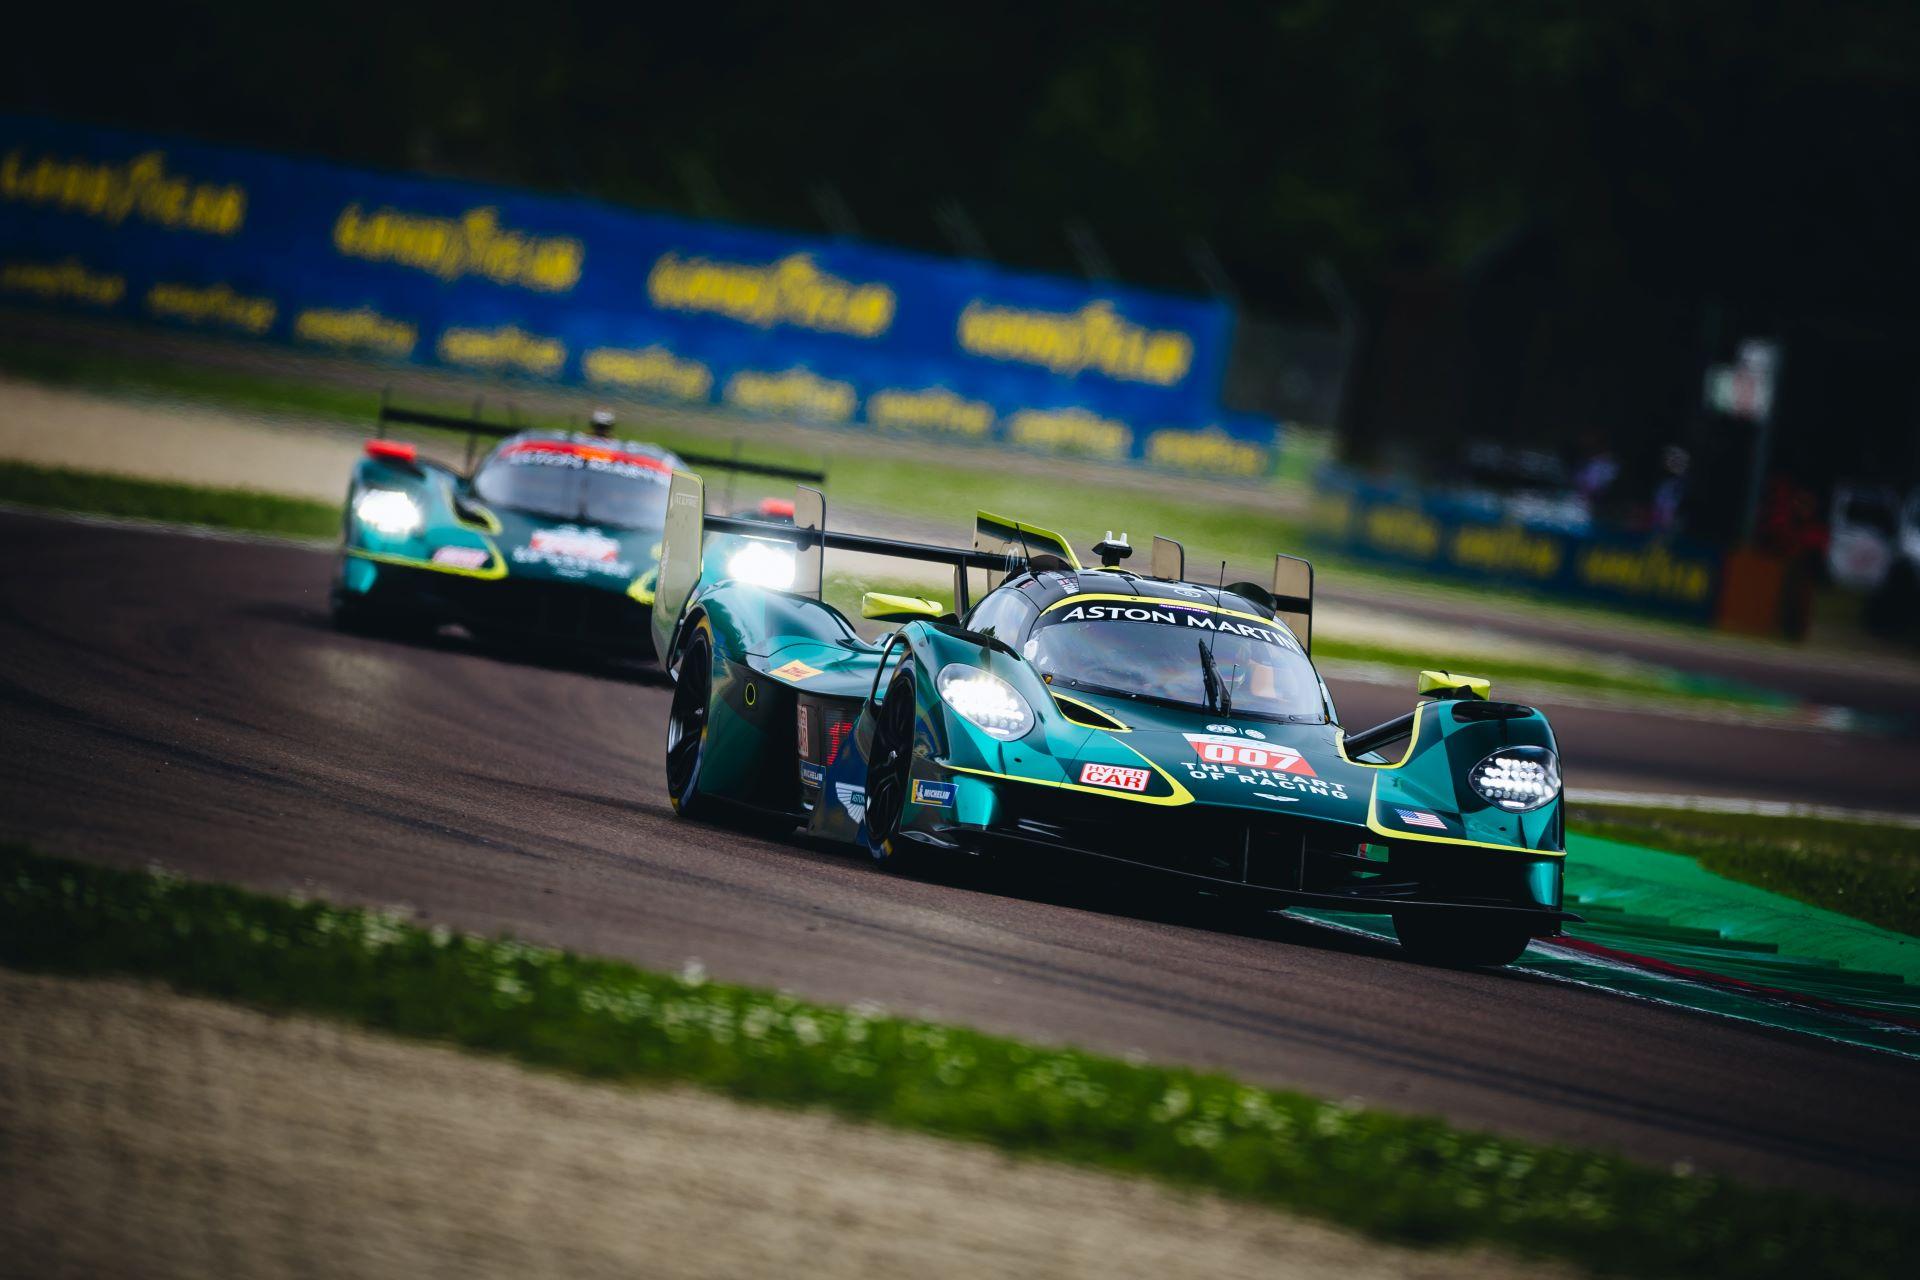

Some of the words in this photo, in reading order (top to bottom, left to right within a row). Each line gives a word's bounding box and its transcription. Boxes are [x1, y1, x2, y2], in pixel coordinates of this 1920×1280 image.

[1061, 606, 1176, 624] ASTON
[1187, 615, 1301, 655] MARTIN
[1204, 744, 1300, 769] 007
[1086, 771, 1142, 788] CAR
[1088, 765, 1144, 778] HYPER
[1181, 762, 1239, 774] THE
[1251, 768, 1346, 791] HEART
[923, 788, 951, 800] MICHELIN
[1189, 770, 1225, 781] OF
[1238, 774, 1349, 800] RACING
